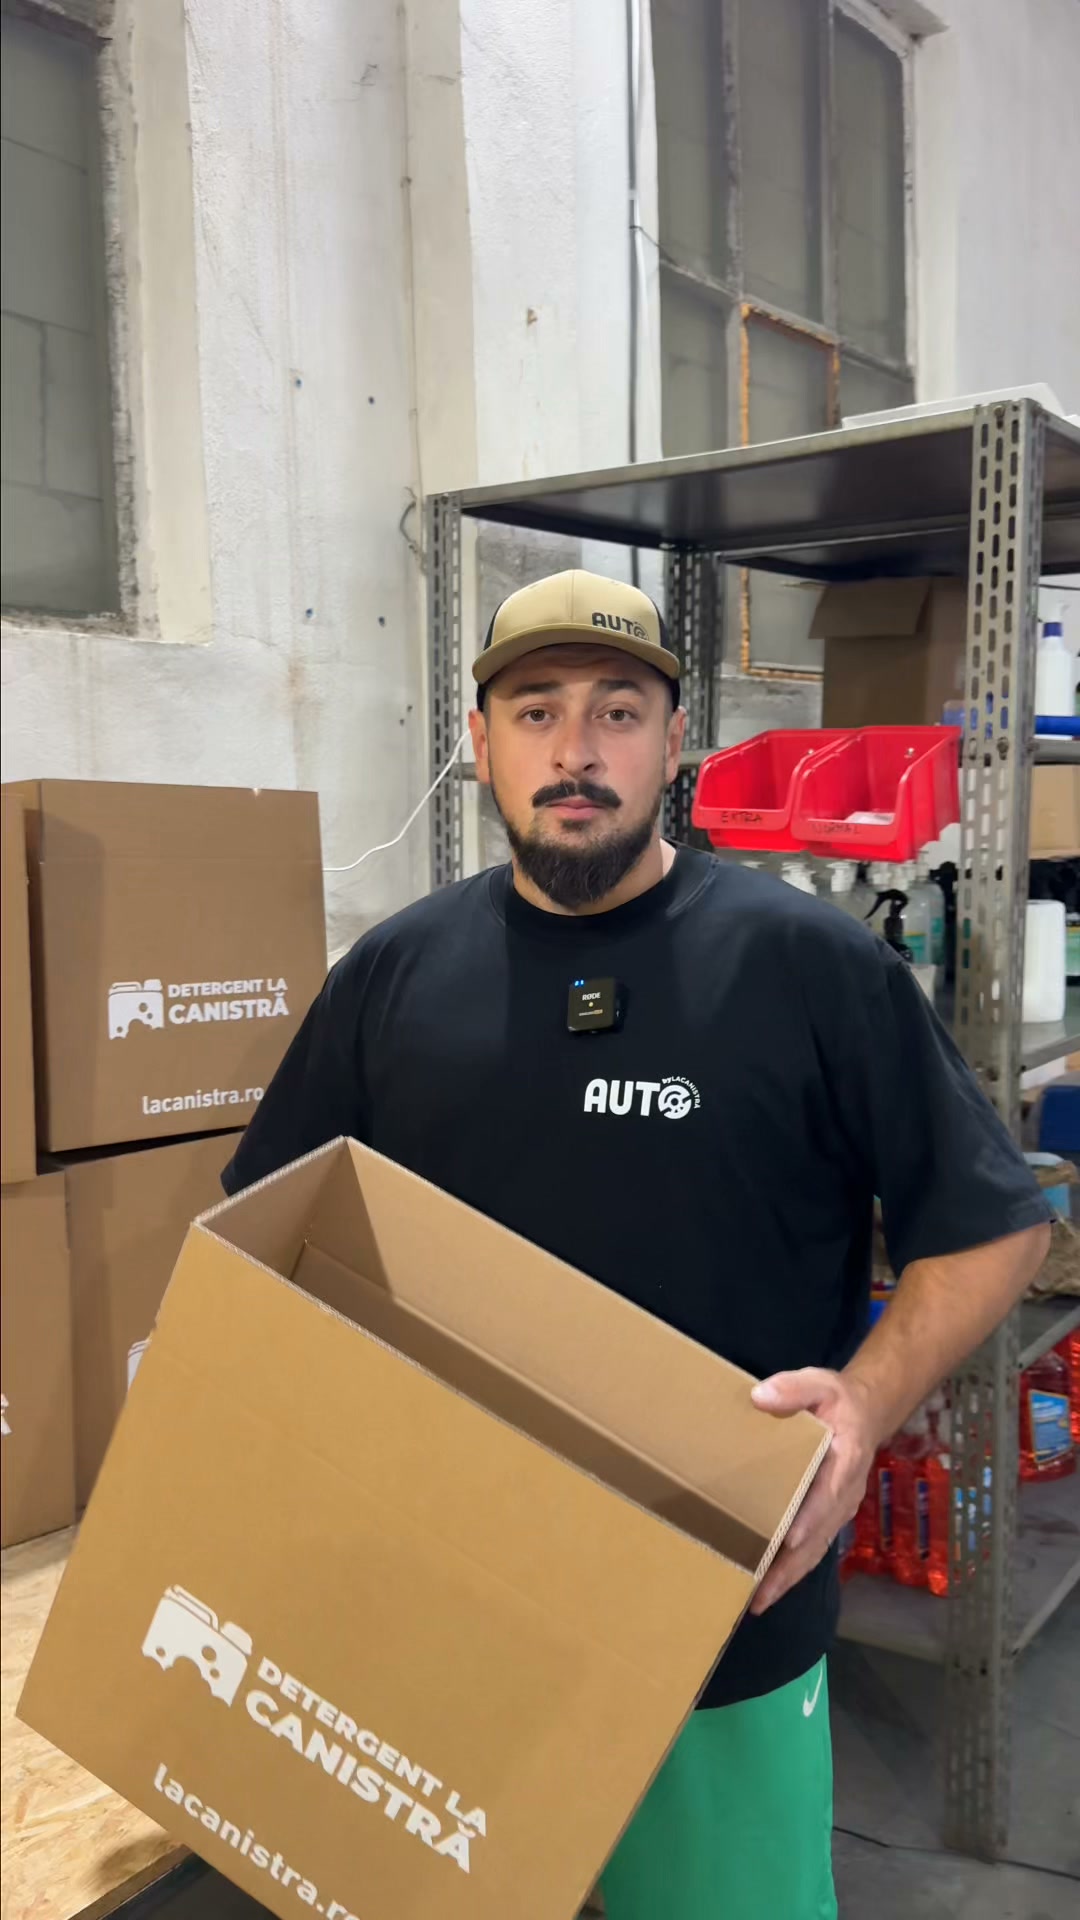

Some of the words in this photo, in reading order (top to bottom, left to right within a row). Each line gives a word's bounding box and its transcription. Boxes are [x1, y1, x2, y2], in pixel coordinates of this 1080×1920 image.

[168, 979, 263, 998] DETERGENT
[267, 977, 289, 992] LA
[168, 992, 289, 1025] CANISTRĂ
[141, 1086, 265, 1115] lacanistra.ro
[583, 1078, 692, 1120] AUTO
[257, 1656, 443, 1797] DETERGENT
[445, 1790, 487, 1837] LA
[245, 1689, 476, 1874] CANISTRĂ
